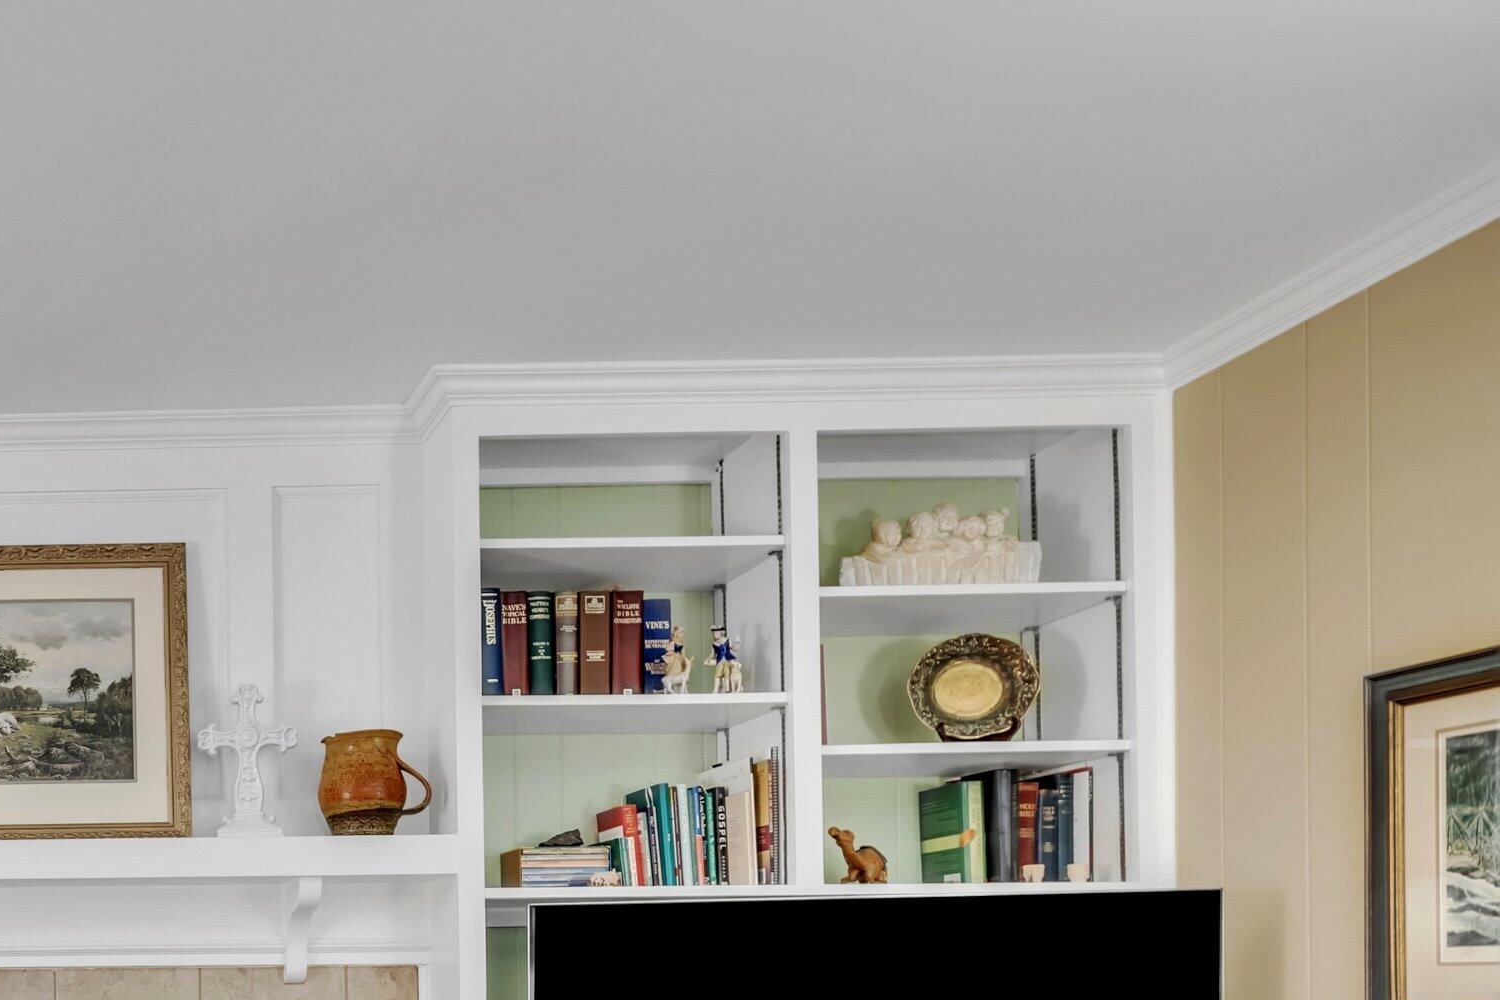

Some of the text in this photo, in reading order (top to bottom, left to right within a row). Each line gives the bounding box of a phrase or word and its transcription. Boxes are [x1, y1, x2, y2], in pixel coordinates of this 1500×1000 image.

[501, 604, 527, 612] NAVE'S
[502, 617, 527, 625] BIBLE
[645, 620, 670, 630] VINE'S
[718, 805, 727, 850] GOSPEL
